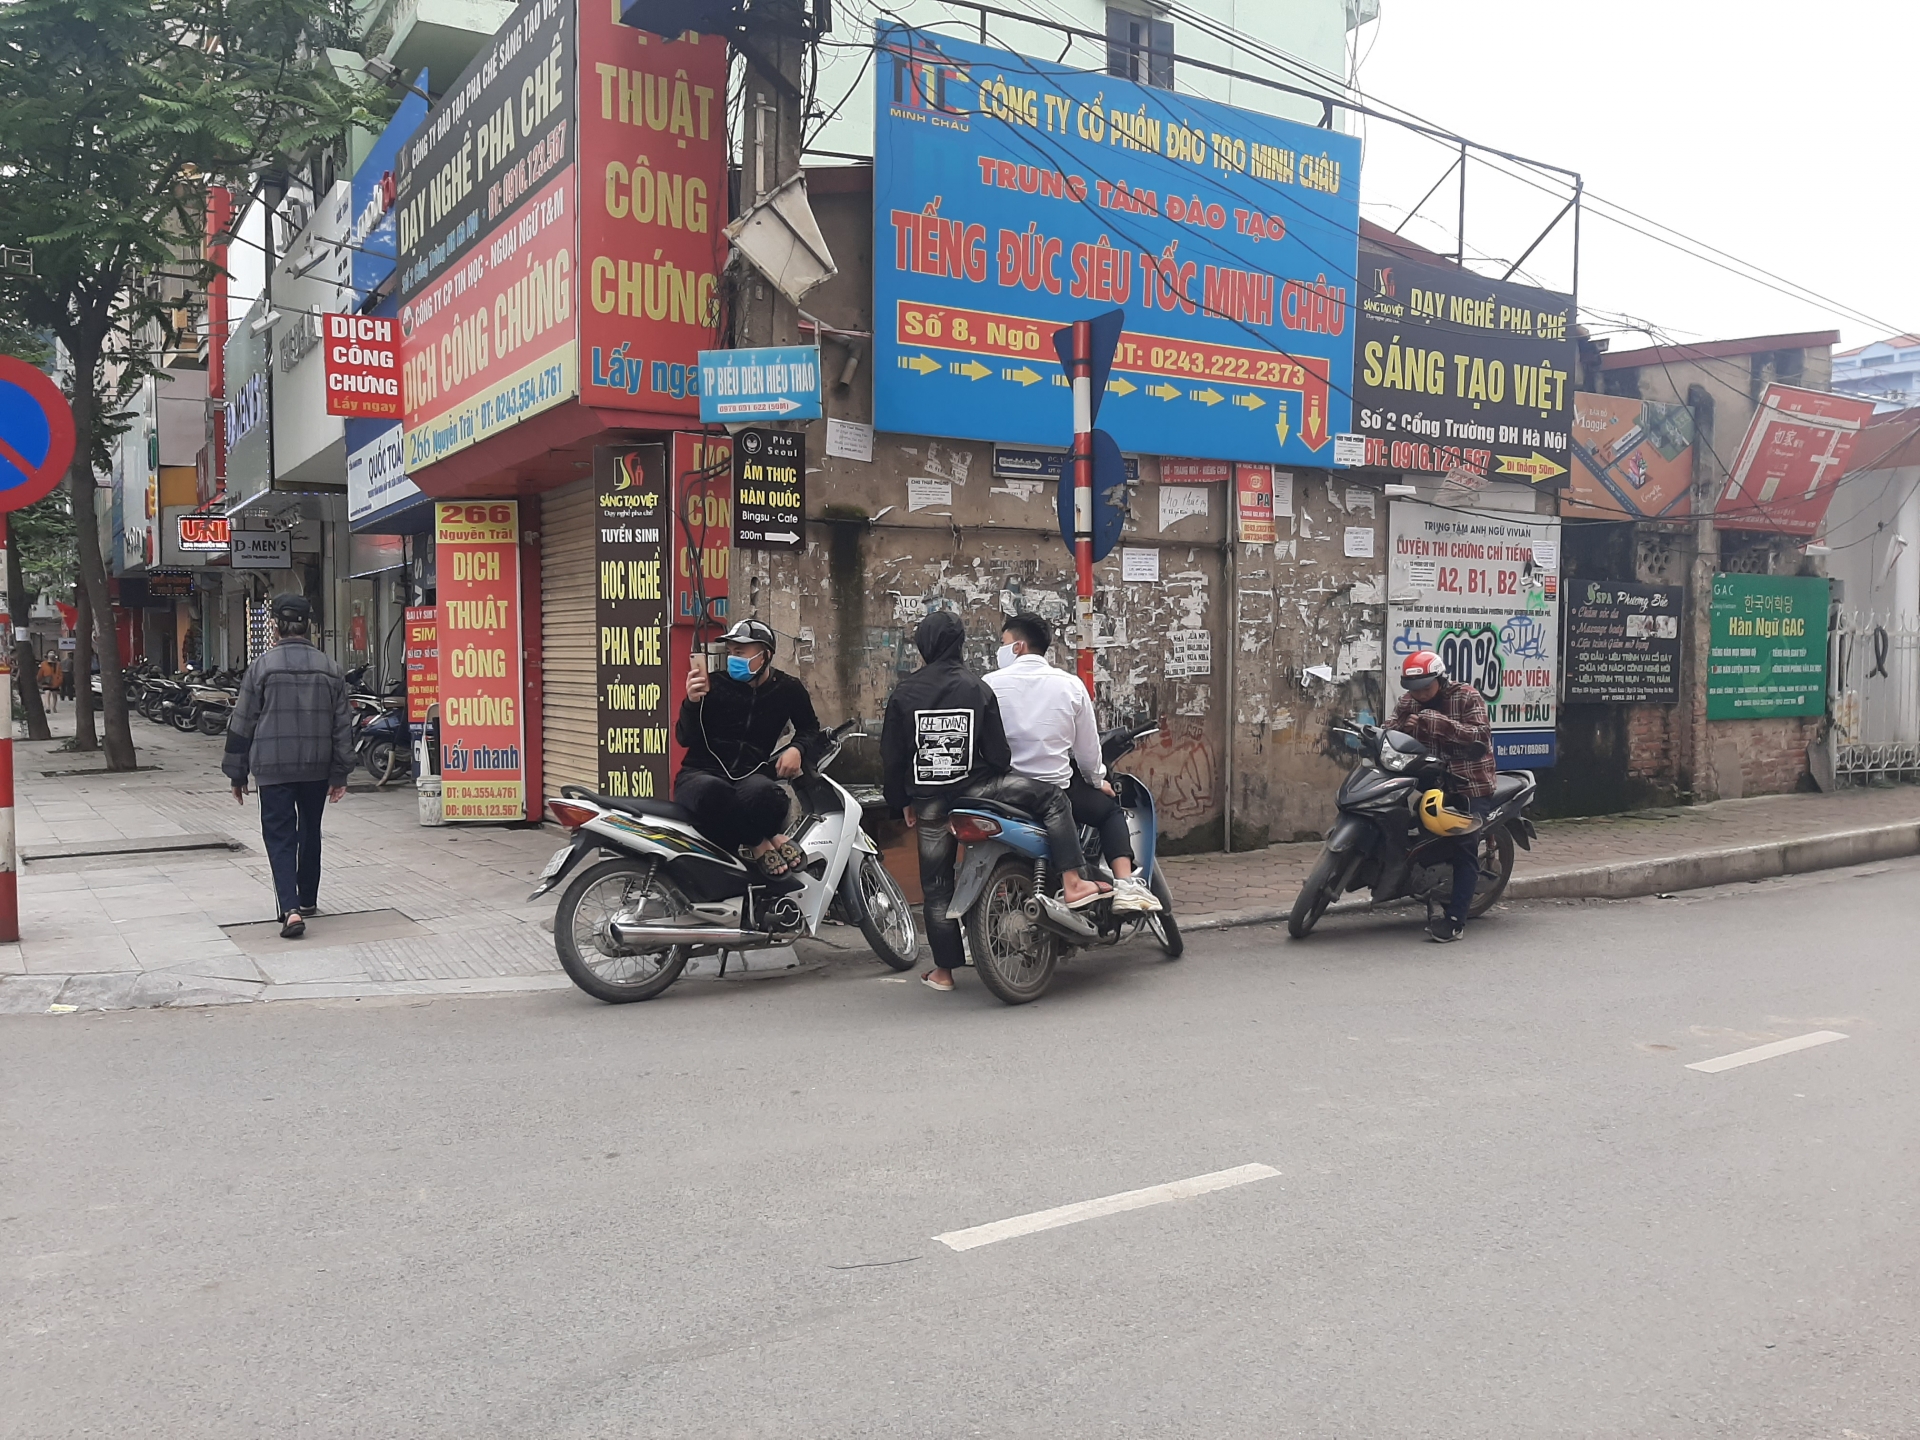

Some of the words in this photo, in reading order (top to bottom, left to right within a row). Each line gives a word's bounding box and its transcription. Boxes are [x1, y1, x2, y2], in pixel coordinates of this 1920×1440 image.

[429, 126, 437, 150] TY
[466, 73, 481, 108] PHA
[482, 42, 498, 89] CHẾ
[500, 24, 521, 70] SÁNG
[524, 2, 540, 43] TẠO
[595, 62, 714, 149] THUẬT
[890, 108, 926, 122] MINH
[932, 117, 969, 132] CHÂU
[400, 187, 426, 256] DẠY
[430, 120, 472, 227] NGHỀ
[477, 97, 515, 182] PHA
[521, 16, 564, 138] CHẾ
[979, 73, 1038, 127] CÔNG
[1044, 93, 1071, 135] TY
[1077, 91, 1105, 143] CỔ
[1110, 103, 1160, 155] PHẦN
[1166, 118, 1206, 165] ĐÀO
[1211, 132, 1246, 179] TẠO
[1251, 142, 1295, 184] MINH
[1299, 151, 1340, 194] CHÂU
[605, 155, 707, 233] CÔNG
[978, 155, 1088, 203] TRUNG
[1096, 180, 1158, 217] TÂM
[1165, 194, 1226, 230] ĐÀO
[1234, 208, 1286, 243] TẠO
[415, 296, 432, 327] CÔNG
[433, 290, 441, 313] TY
[443, 280, 452, 306] CP
[454, 268, 466, 298] TIN
[468, 254, 483, 288] HỌC
[491, 226, 516, 269] NGOẠI
[519, 201, 538, 247] NGỮ
[541, 187, 564, 229] T&M
[891, 195, 987, 283] TIẾNG
[996, 221, 1062, 295] ĐỨC
[1070, 233, 1131, 305] SIÊU
[1140, 239, 1197, 315] TỐC
[1203, 265, 1274, 326] MINH
[1280, 273, 1346, 337] CHÂU
[591, 249, 719, 328] CHỨNG
[331, 316, 392, 343] DỊCH
[1411, 288, 1445, 324] DẠY
[1451, 293, 1495, 329] NGHỀ
[1500, 305, 1532, 335] PHA
[1537, 308, 1568, 342] CHẾ
[402, 343, 437, 423] DỊCH
[441, 314, 489, 393] CÔNG
[494, 249, 570, 358] CHỨNG
[904, 311, 945, 338] Số
[952, 318, 977, 345] 8,
[987, 322, 1040, 350] Ngõ
[1150, 348, 1305, 385] 0243.222.2373
[332, 345, 394, 368] CÔNG
[591, 341, 642, 398] Lấy
[329, 371, 398, 396] CHỨNG
[703, 367, 715, 396] TP
[717, 355, 739, 396] BIỂU
[742, 355, 764, 395] DIỄN
[766, 355, 788, 394] HIẾU
[790, 357, 815, 392] THẢO
[1363, 336, 1445, 395] SÁNG
[1454, 355, 1505, 409] TẠO
[1513, 360, 1567, 418] VIỆT
[333, 396, 358, 411] Lấy
[362, 400, 396, 413] ngay
[410, 426, 431, 465] 266
[495, 363, 562, 422] 0243.554.4761
[773, 436, 792, 446] Phố
[1360, 408, 1383, 429] Số
[1386, 412, 1396, 430] 2
[1402, 412, 1440, 438] Cổng
[1445, 419, 1494, 443] Trường
[1499, 426, 1519, 444] ĐH
[1523, 427, 1539, 447] Hà
[1544, 431, 1567, 452] Nội
[368, 438, 386, 485] QUỐC
[768, 446, 797, 458] Seoul
[1365, 437, 1388, 466] ĐT:
[1391, 441, 1491, 475] 0916.123.567
[743, 458, 763, 482] ẨM
[766, 466, 797, 485] THỰC
[441, 505, 511, 524] 266
[600, 493, 623, 507] SÁNG
[624, 495, 640, 509] TẠO
[640, 492, 658, 509] VIỆT
[740, 487, 765, 506] HÀN
[768, 487, 800, 508] QUỐC
[439, 527, 482, 541] Nguyễn
[484, 528, 513, 540] Trãi
[601, 523, 633, 543] TUYỂN
[635, 528, 659, 543] SINH
[742, 511, 769, 522] Bingsu
[778, 513, 798, 524] Cafe
[1424, 521, 1450, 535] TRUNG
[1470, 526, 1486, 534] ANH
[1488, 524, 1504, 535] NGỮ
[1507, 527, 1531, 538] VIVIAN
[740, 530, 762, 540] 200m
[1397, 537, 1429, 559] LUYỆN
[1432, 541, 1447, 557] THI
[1451, 541, 1484, 559] CHỨNG
[1487, 542, 1503, 560] CHỈ
[1506, 542, 1532, 562] TIẾNG
[453, 551, 500, 587] DỊCH
[601, 561, 625, 609] HỌC
[629, 546, 661, 600] NGHỀ
[1437, 567, 1462, 596] A2,
[1468, 569, 1492, 597] B1,
[1497, 570, 1517, 594] B2
[1596, 592, 1613, 605] SPA
[1714, 584, 1734, 596] GAC
[446, 594, 508, 636] THUẬT
[1729, 617, 1752, 636] Hàn
[1756, 617, 1779, 638] Ngữ
[1782, 618, 1804, 636] GAC
[412, 626, 436, 642] SIM
[601, 626, 630, 666] PHA
[634, 612, 662, 666] CHẾ
[451, 643, 506, 679] CÔNG
[1443, 637, 1497, 691] 90%
[607, 674, 636, 710] TỔNG
[639, 682, 661, 716] HỢP
[1501, 669, 1522, 691] HỌC
[1526, 666, 1550, 687] VIÊN
[445, 689, 514, 727] CHỨNG
[937, 716, 967, 730] TWINS
[1501, 704, 1520, 722] THI
[443, 738, 469, 773] Lấy
[473, 744, 519, 770] nhanh
[607, 727, 640, 754] CAFFE
[643, 723, 668, 754] MÁY
[608, 766, 629, 797] TRÀ
[632, 765, 654, 798] SỮA
[461, 804, 518, 817] 0916.123.567
